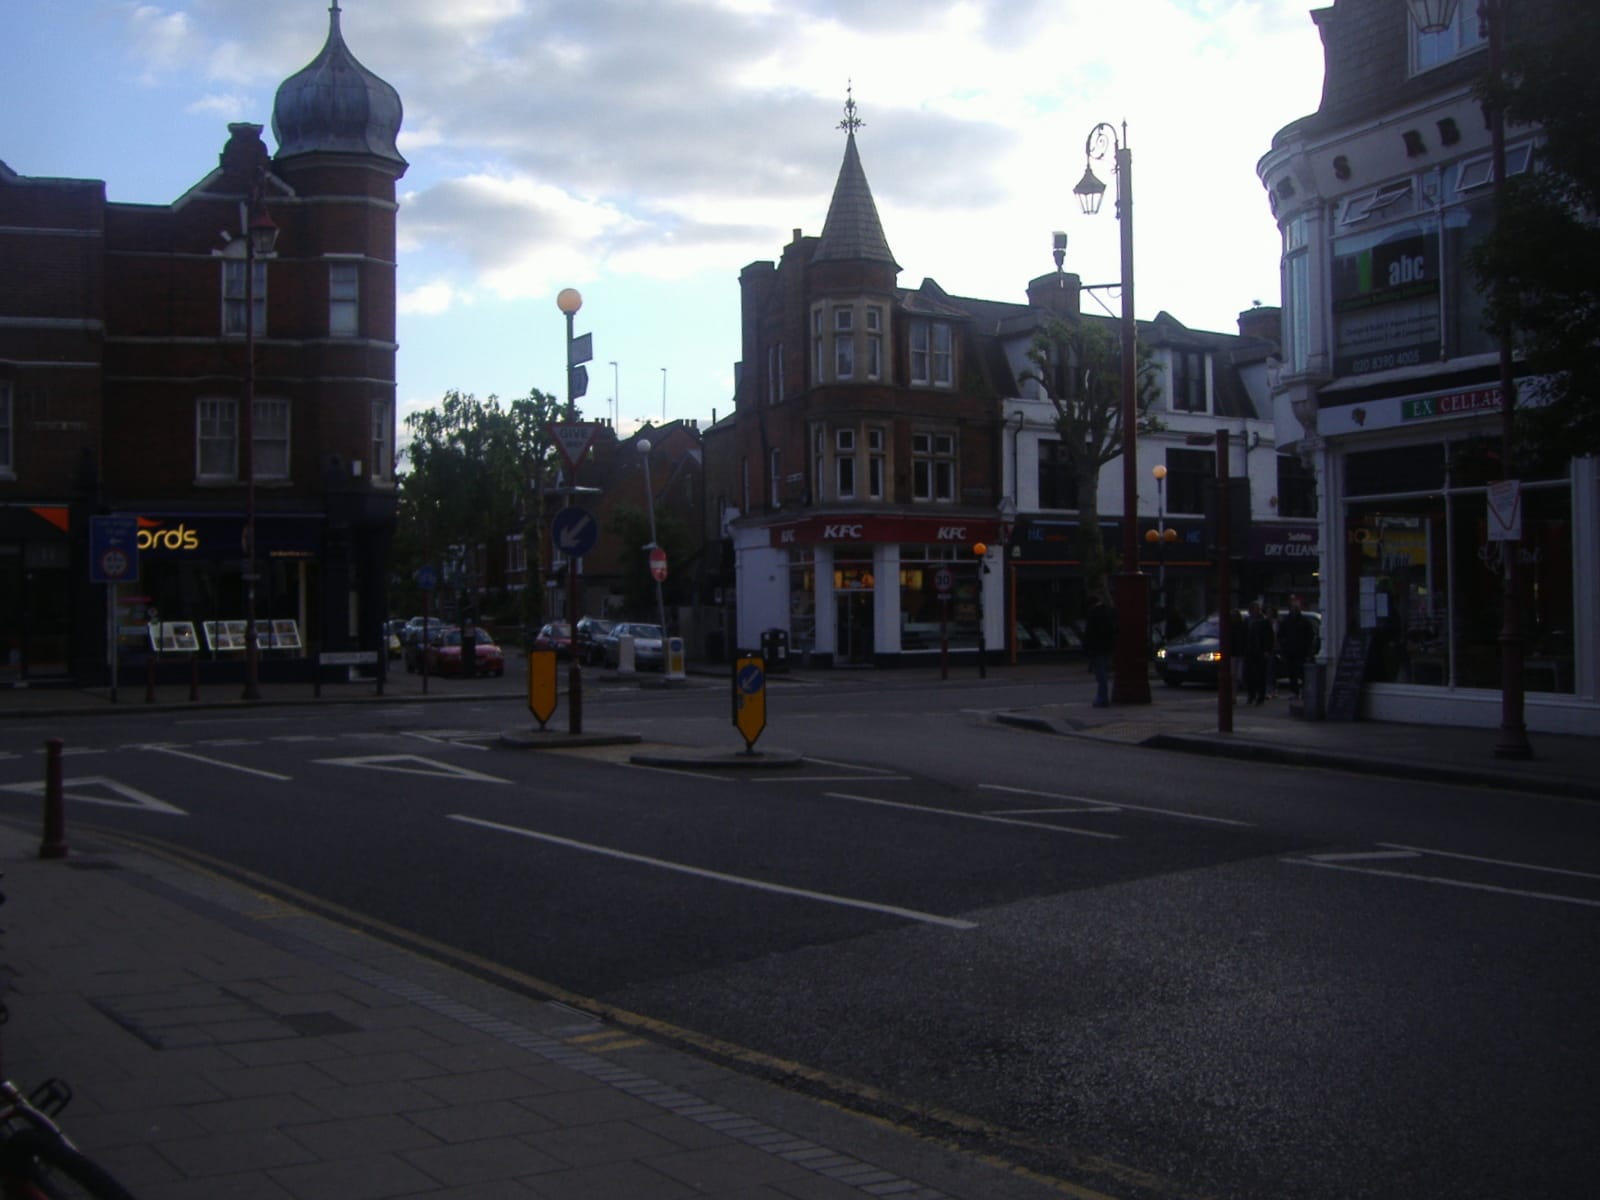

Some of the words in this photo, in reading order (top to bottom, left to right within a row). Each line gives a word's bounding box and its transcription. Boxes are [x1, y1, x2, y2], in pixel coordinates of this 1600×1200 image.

[1388, 254, 1424, 287] abc
[1412, 400, 1433, 417] EX
[560, 428, 588, 438] GIVE
[823, 524, 864, 539] KFC
[937, 526, 967, 540] KFC
[1264, 544, 1284, 556] DRY
